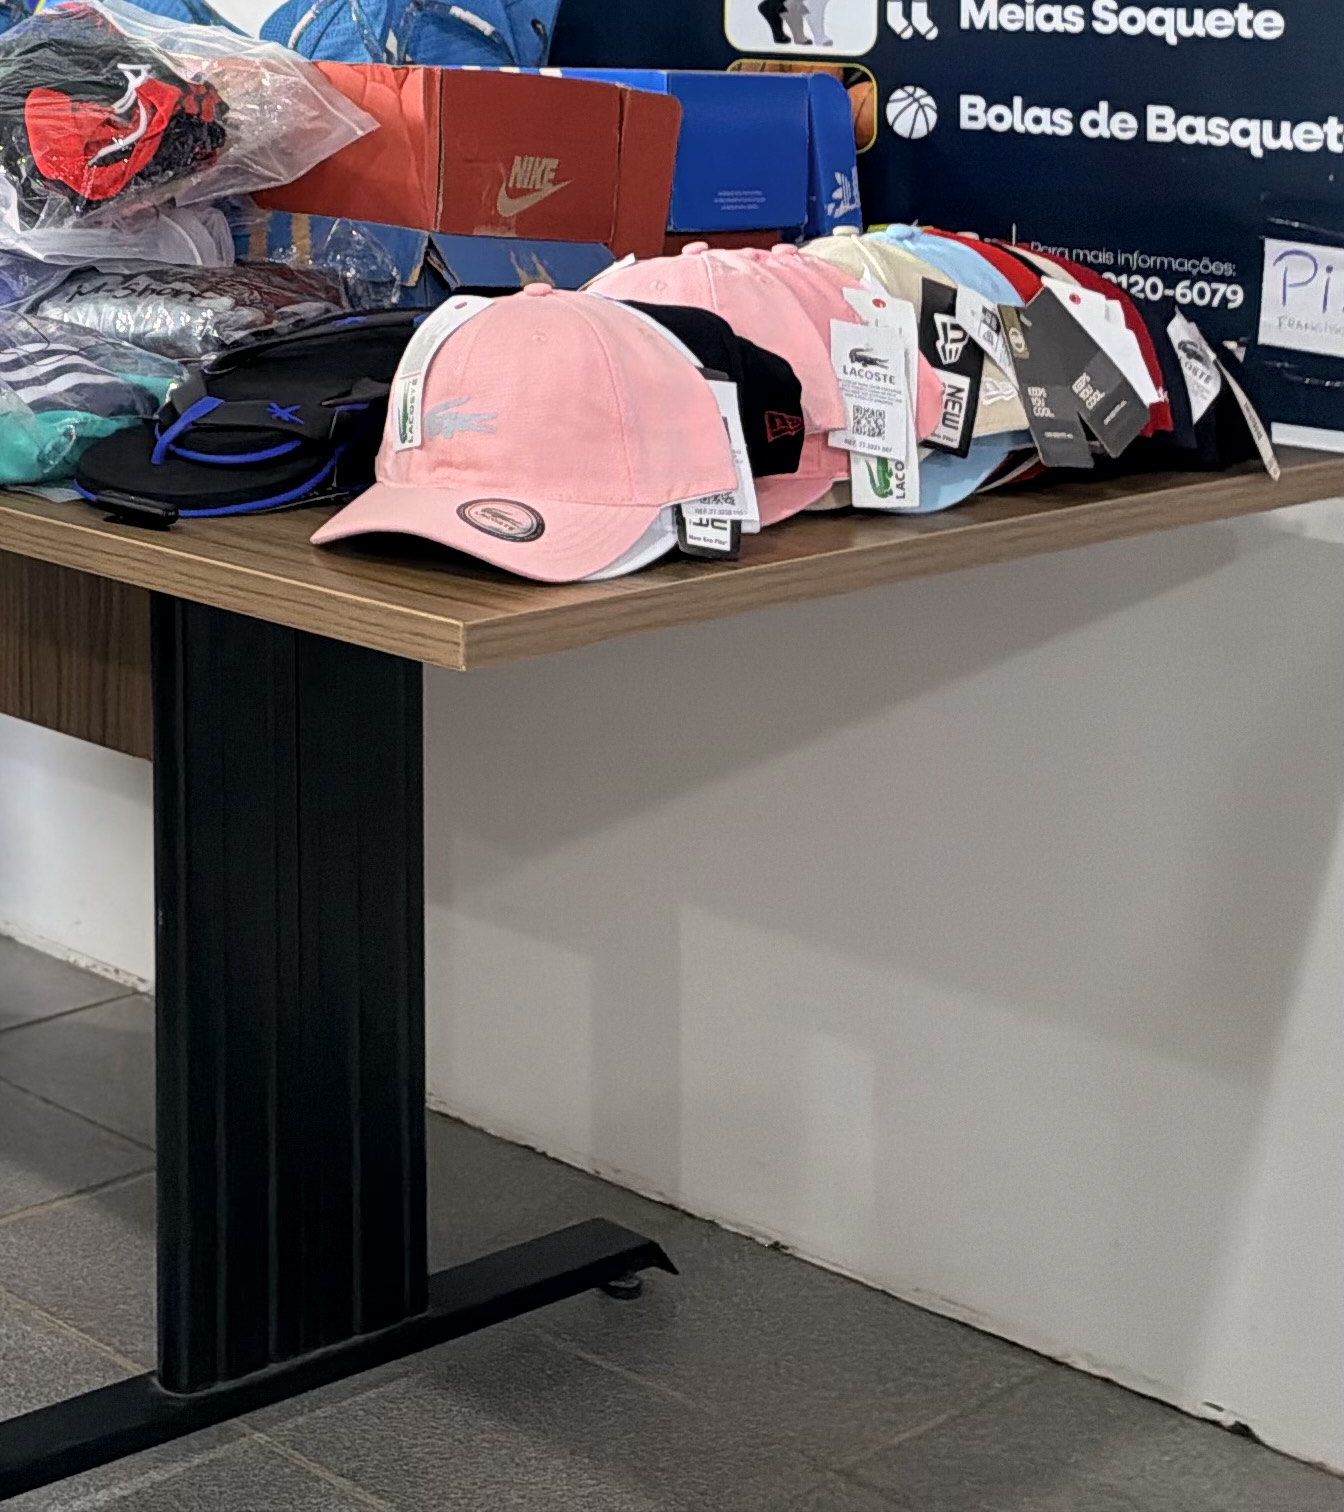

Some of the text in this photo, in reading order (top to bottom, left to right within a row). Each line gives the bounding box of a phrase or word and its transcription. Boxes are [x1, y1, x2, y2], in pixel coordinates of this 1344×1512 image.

[959, 93, 1344, 159] Bolas de Basquet
[508, 155, 559, 190] NIKE
[1072, 247, 1114, 266] mais
[1117, 248, 1237, 277] informações:
[1273, 249, 1344, 315] Pi
[842, 364, 896, 386] LACOSTE
[941, 383, 966, 431] NEW
